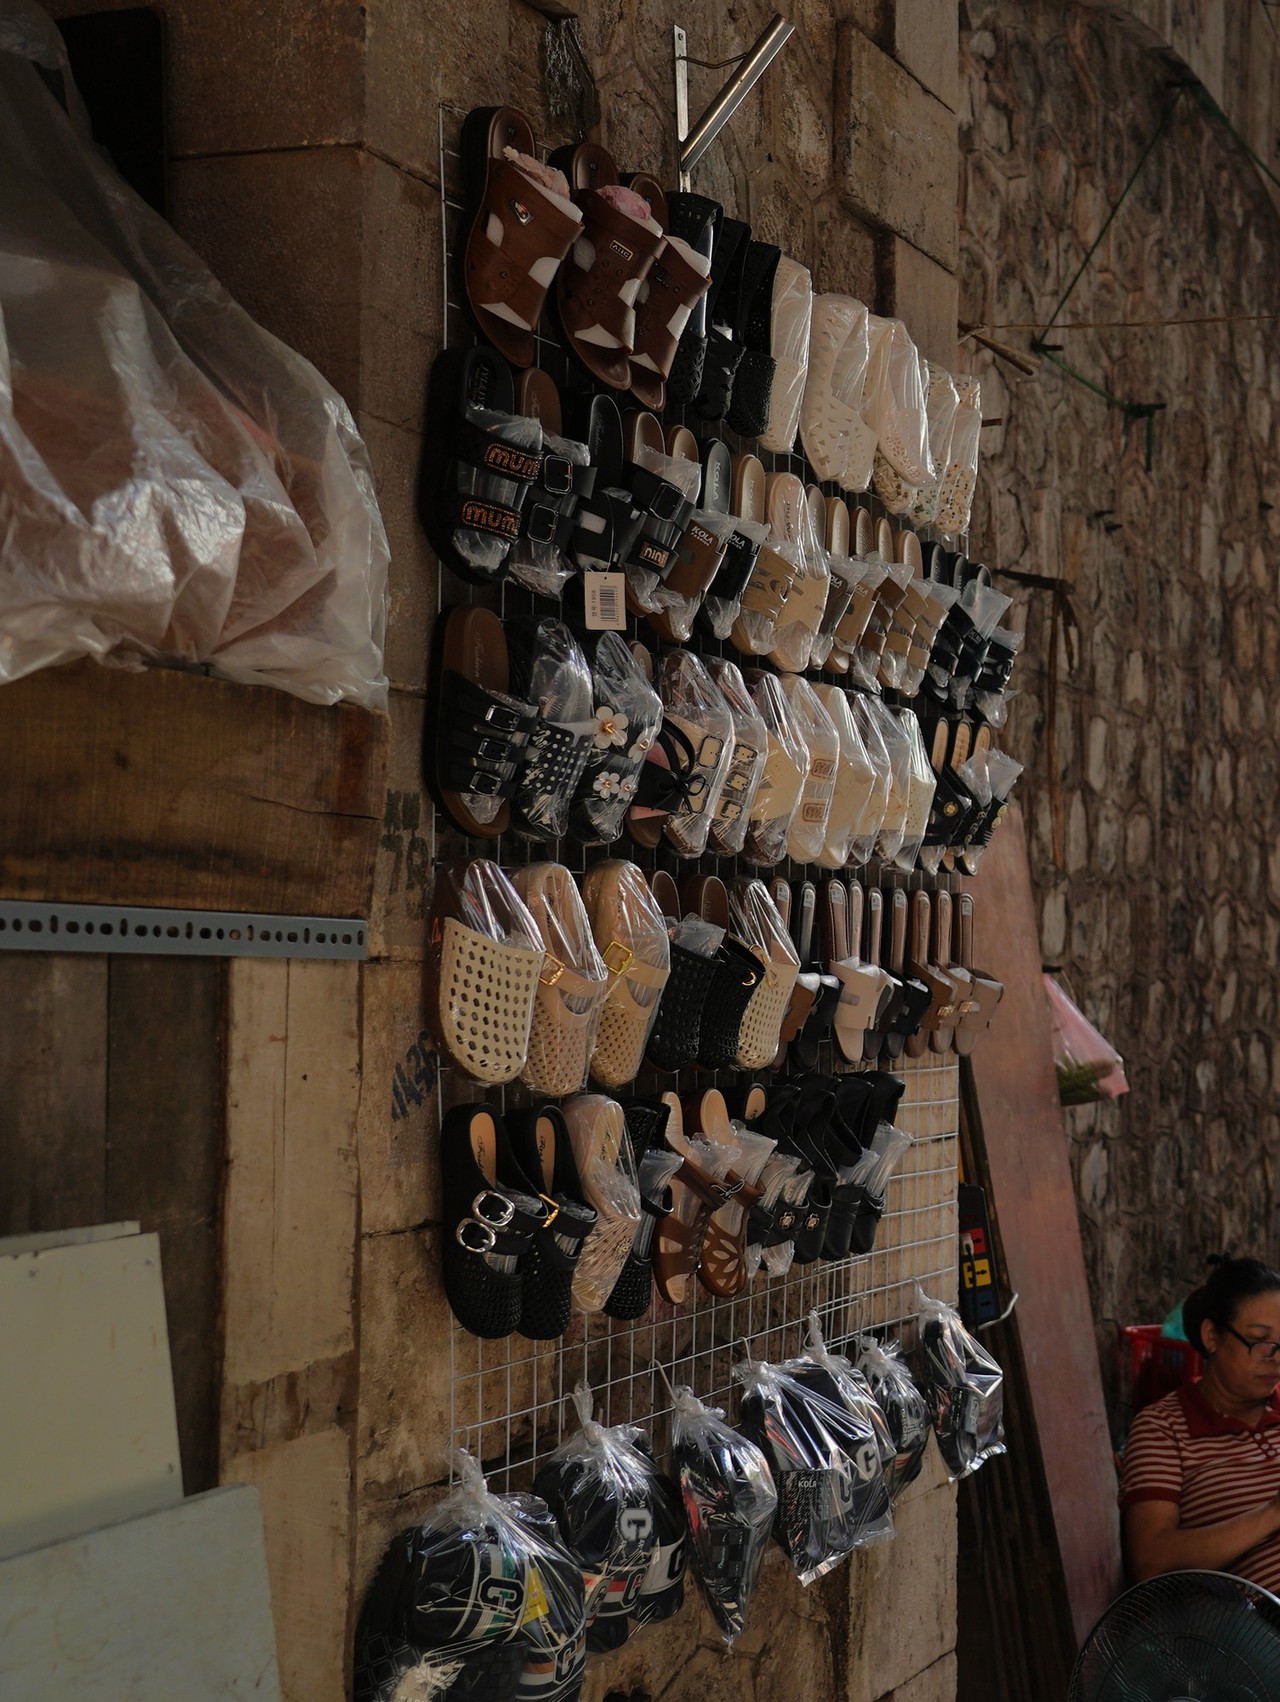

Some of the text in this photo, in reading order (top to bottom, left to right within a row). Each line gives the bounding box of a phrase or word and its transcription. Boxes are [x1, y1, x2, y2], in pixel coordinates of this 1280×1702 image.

[691, 526, 714, 545] KOLA
[731, 533, 746, 547] OLA
[830, 575, 843, 587] OLA
[855, 584, 869, 597] OLA
